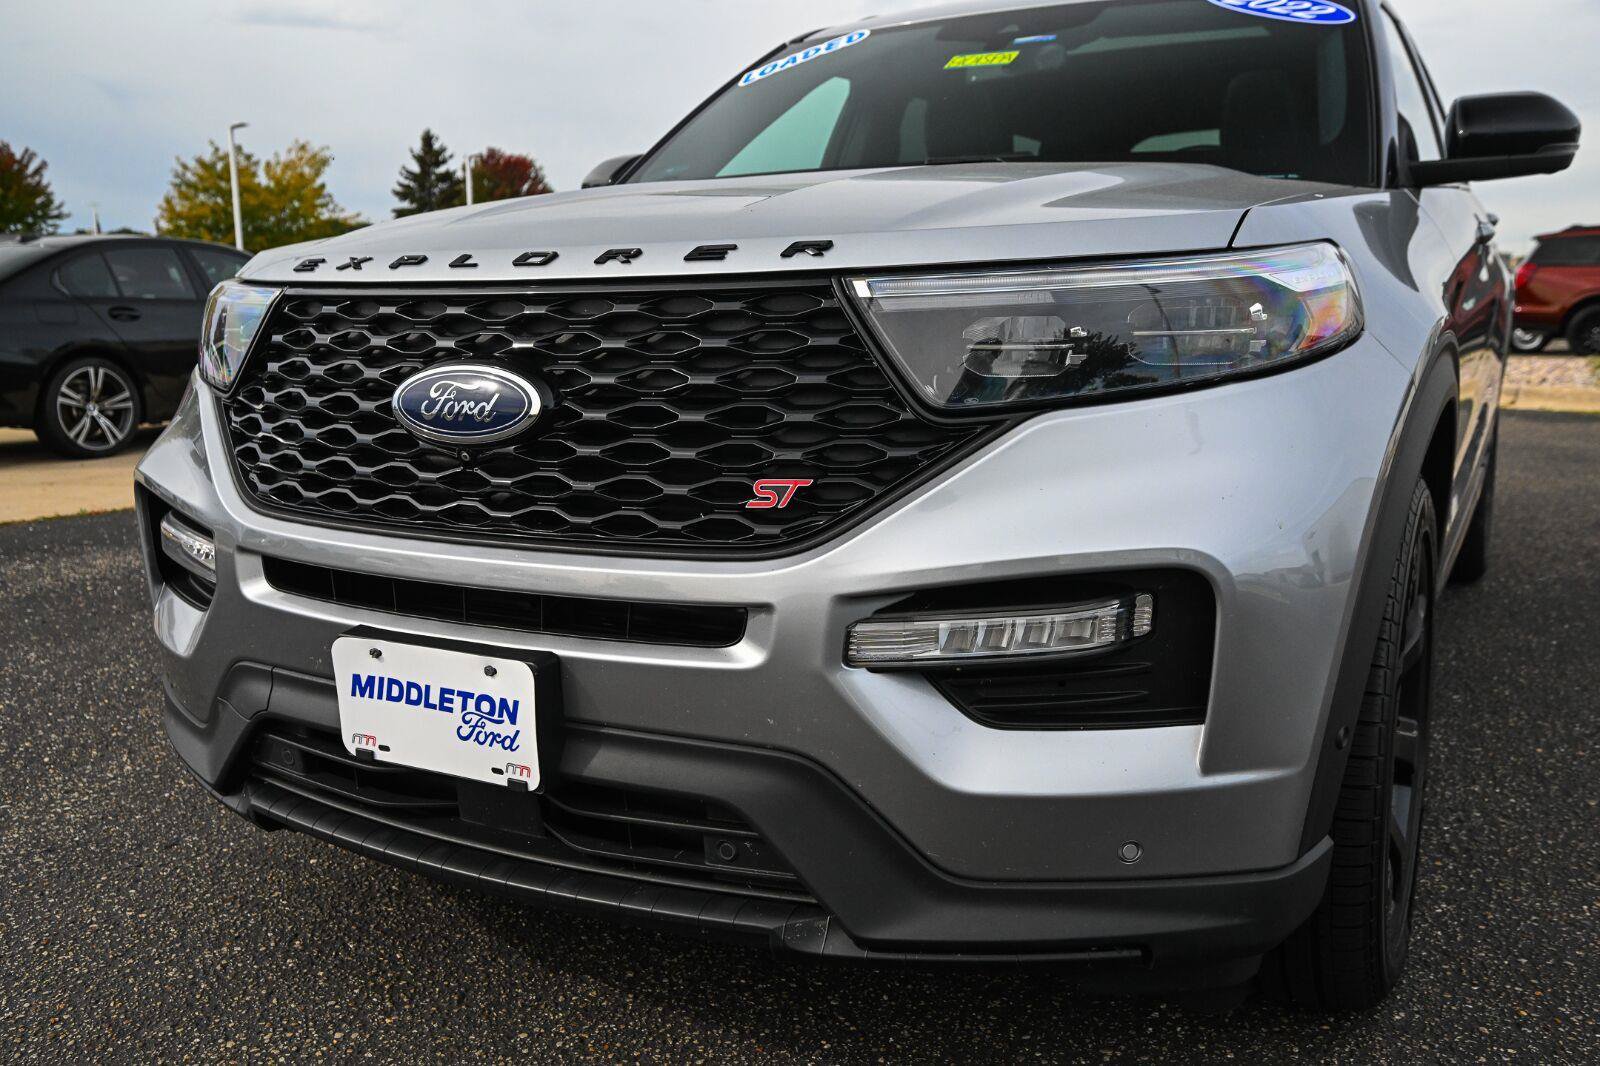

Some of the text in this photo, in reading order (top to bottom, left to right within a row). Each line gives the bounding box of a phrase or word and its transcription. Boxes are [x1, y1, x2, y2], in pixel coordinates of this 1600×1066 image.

[743, 32, 865, 84] LOADED
[294, 240, 833, 272] EXPLORER
[421, 380, 500, 422] Ford
[745, 479, 814, 508] ST
[351, 674, 519, 725] MIDDLETON
[456, 711, 520, 752] Ford
